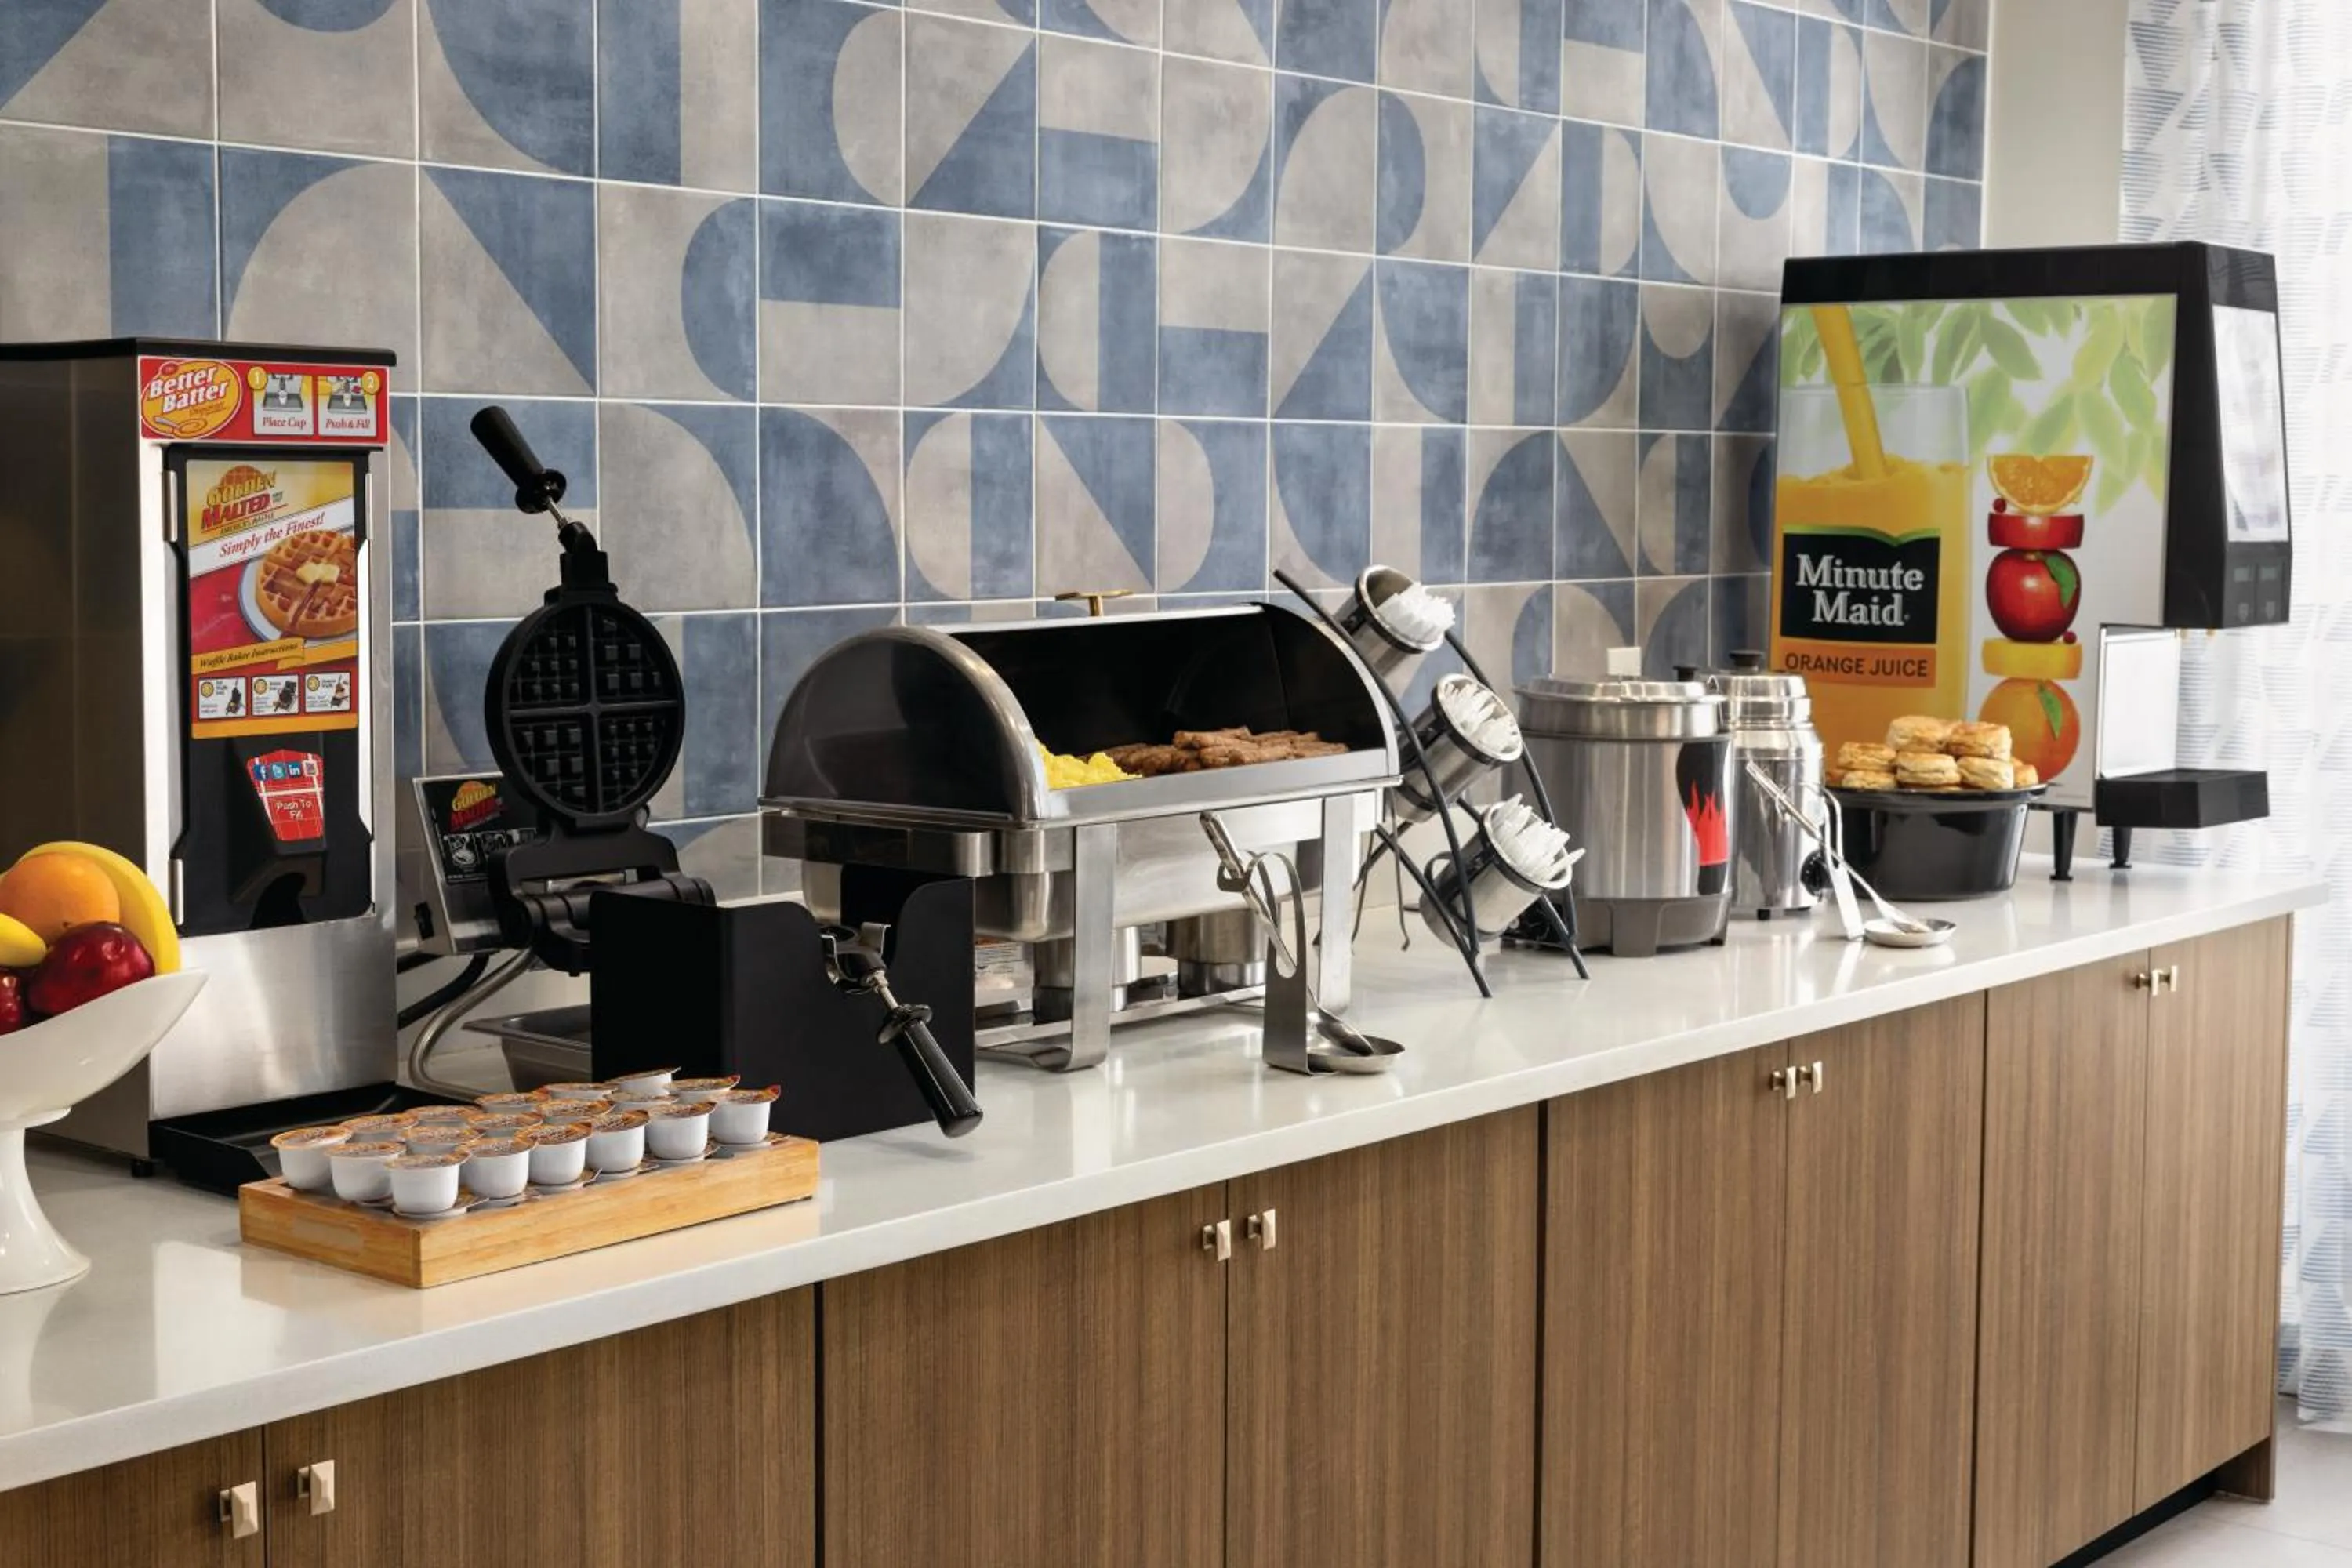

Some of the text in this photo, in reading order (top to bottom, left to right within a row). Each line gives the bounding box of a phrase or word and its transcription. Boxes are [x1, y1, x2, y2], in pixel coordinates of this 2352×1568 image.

[149, 366, 217, 398] Better
[162, 381, 229, 414] Batter
[201, 493, 270, 528] MALTED
[220, 533, 260, 557] Simply
[265, 528, 283, 543] the
[285, 511, 325, 535] Finest!
[1795, 553, 1925, 591] Minute
[1811, 590, 1905, 626] Maid
[1784, 652, 1928, 677] ORANGE JUICE
